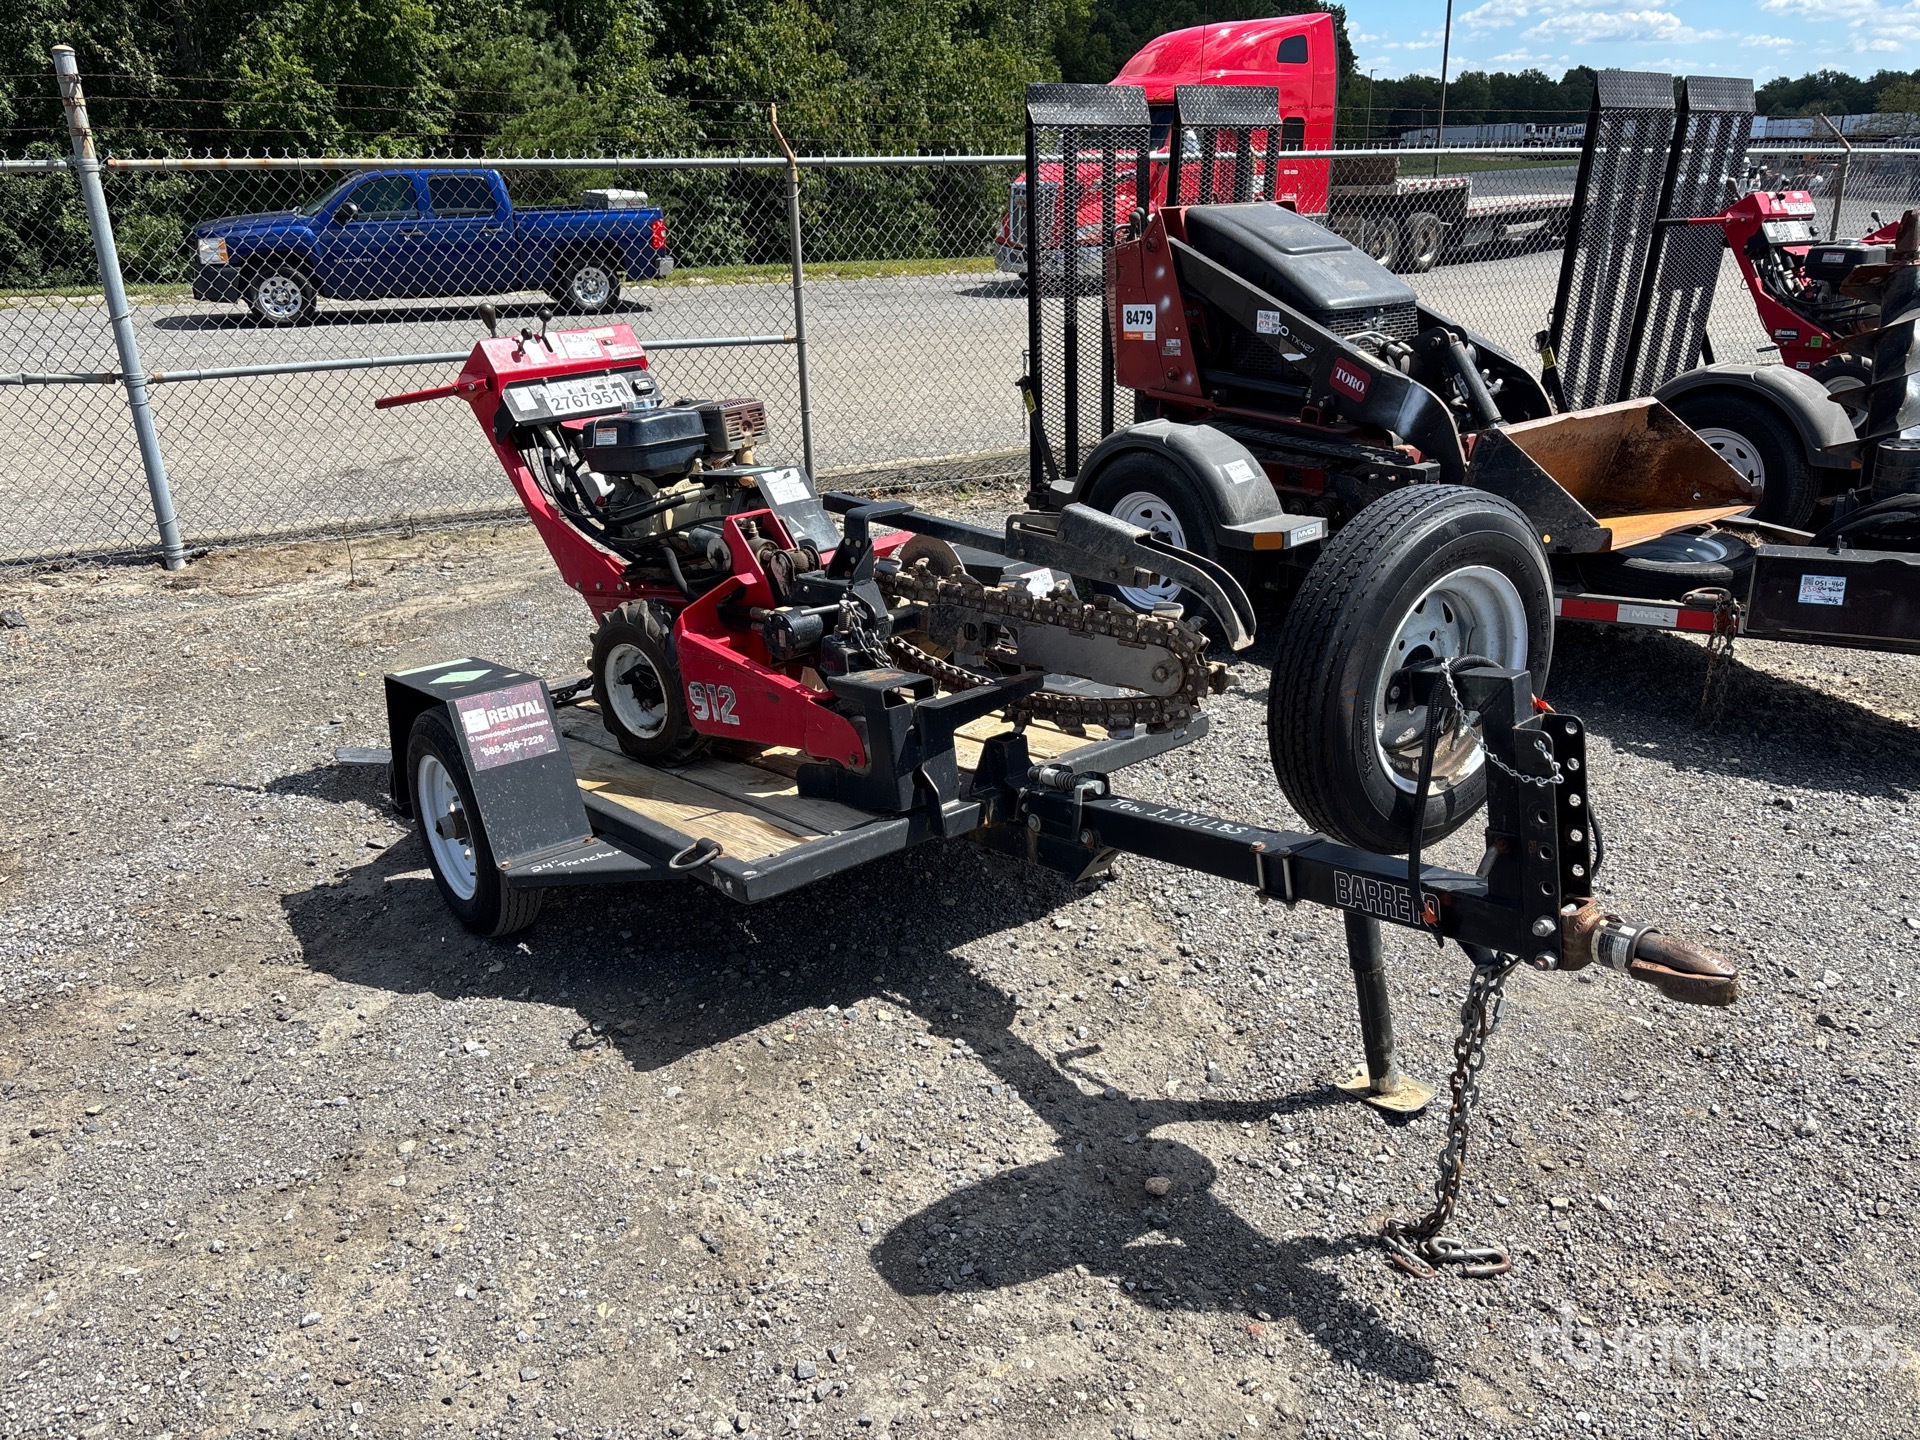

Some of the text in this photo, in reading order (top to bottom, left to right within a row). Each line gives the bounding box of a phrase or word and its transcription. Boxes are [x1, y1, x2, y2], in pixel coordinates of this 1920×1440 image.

[1126, 310, 1153, 325] 8479
[1335, 366, 1365, 393] TORO
[550, 389, 622, 411] 2767951
[486, 699, 545, 726] RENTAL
[688, 681, 740, 726] 912
[1110, 798, 1145, 813] Tow
[557, 849, 622, 868] Trencher
